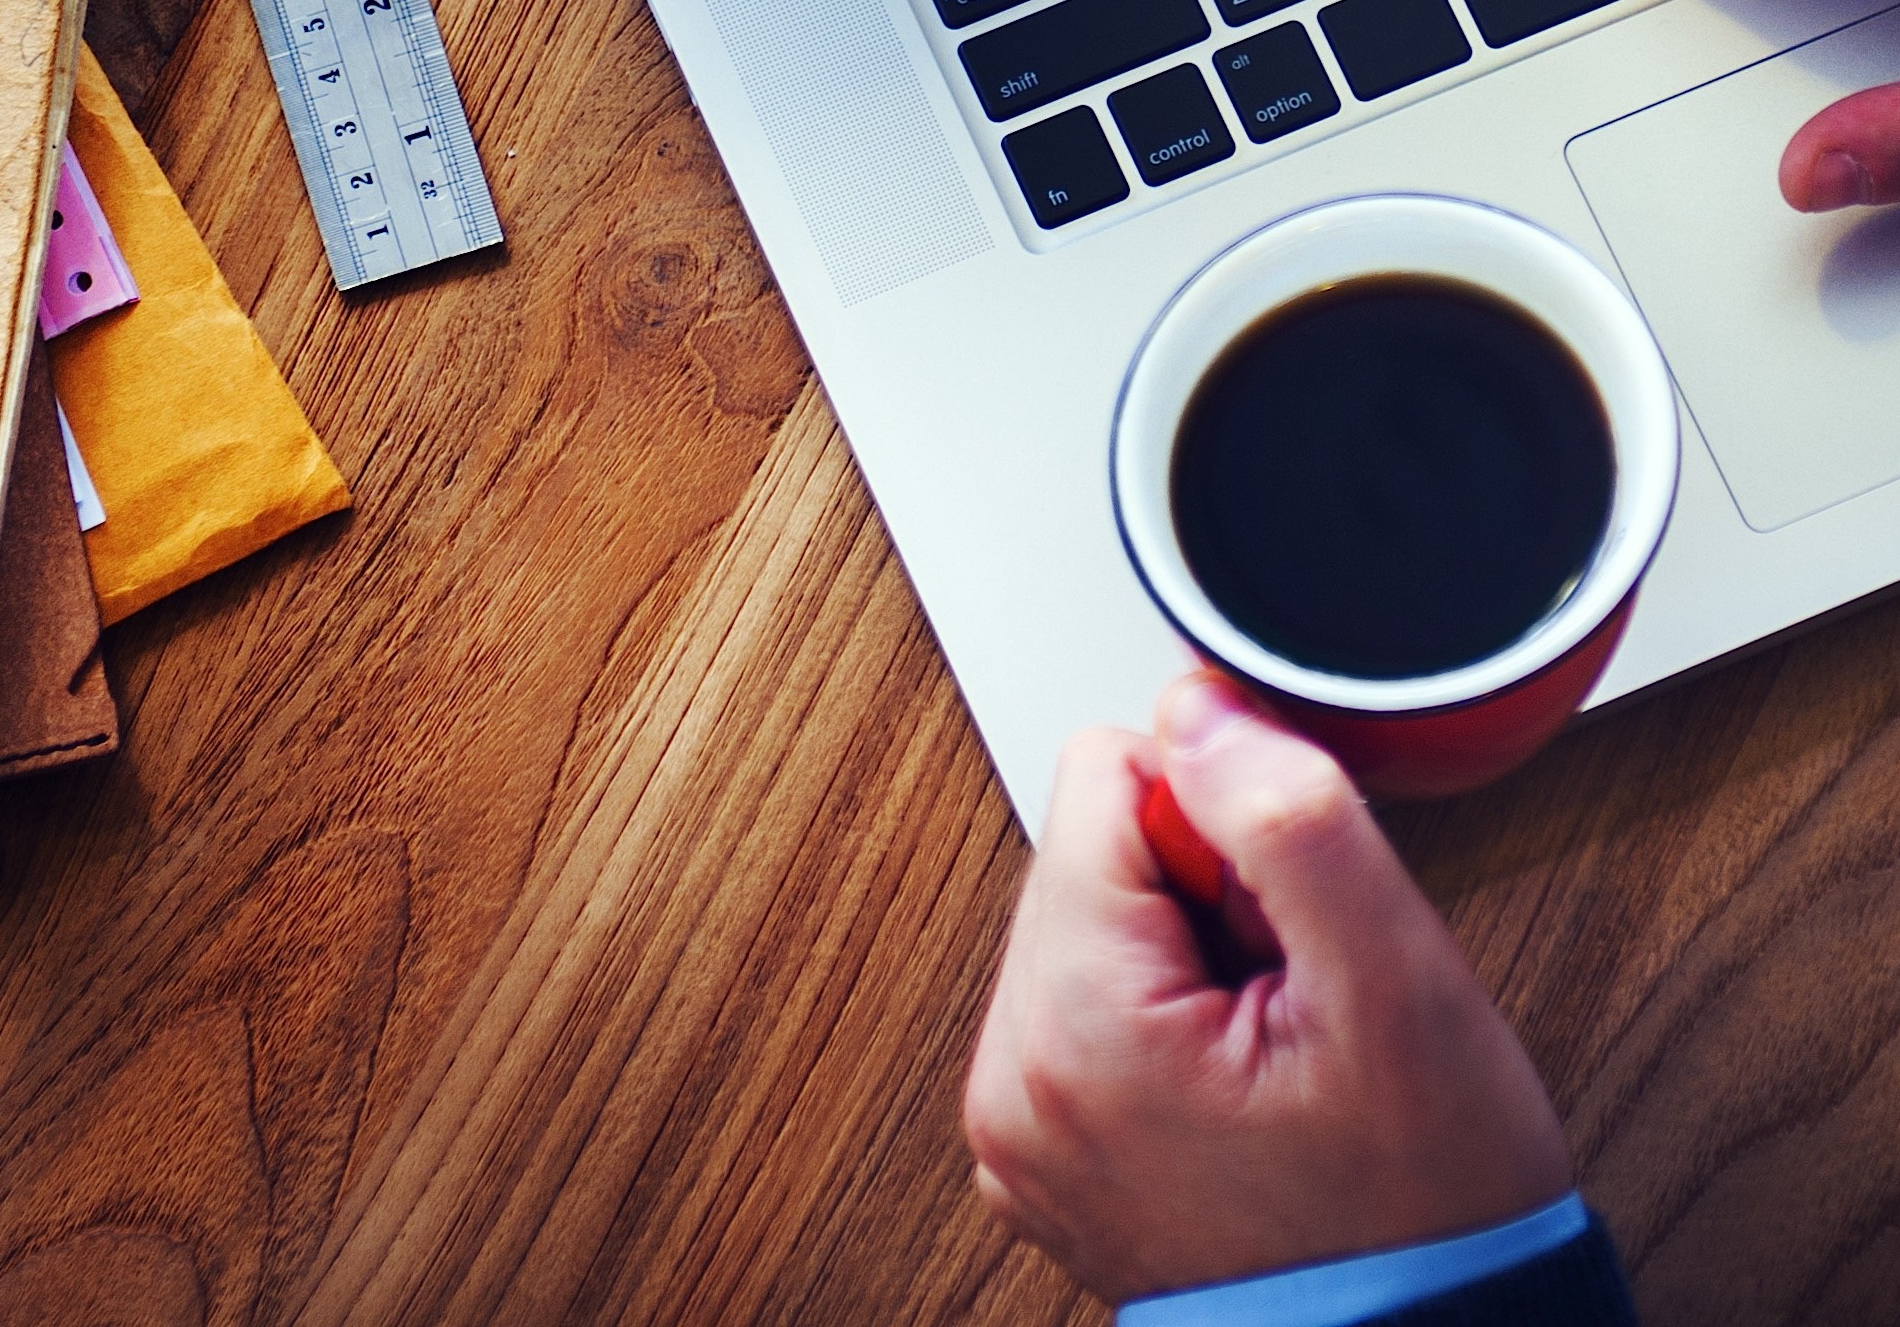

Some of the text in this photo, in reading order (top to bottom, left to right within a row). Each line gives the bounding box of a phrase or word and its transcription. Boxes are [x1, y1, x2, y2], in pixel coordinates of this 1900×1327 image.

[304, 17, 325, 33] 5
[1231, 54, 1250, 70] alt
[317, 69, 341, 86] 4
[1000, 72, 1039, 98] shift
[1256, 92, 1312, 122] option
[334, 120, 357, 138] 3
[405, 125, 433, 146] 1
[1149, 128, 1210, 165] control
[350, 172, 373, 189] 2
[422, 180, 439, 200] 32
[1048, 190, 1069, 206] fn
[366, 223, 390, 240] 1
